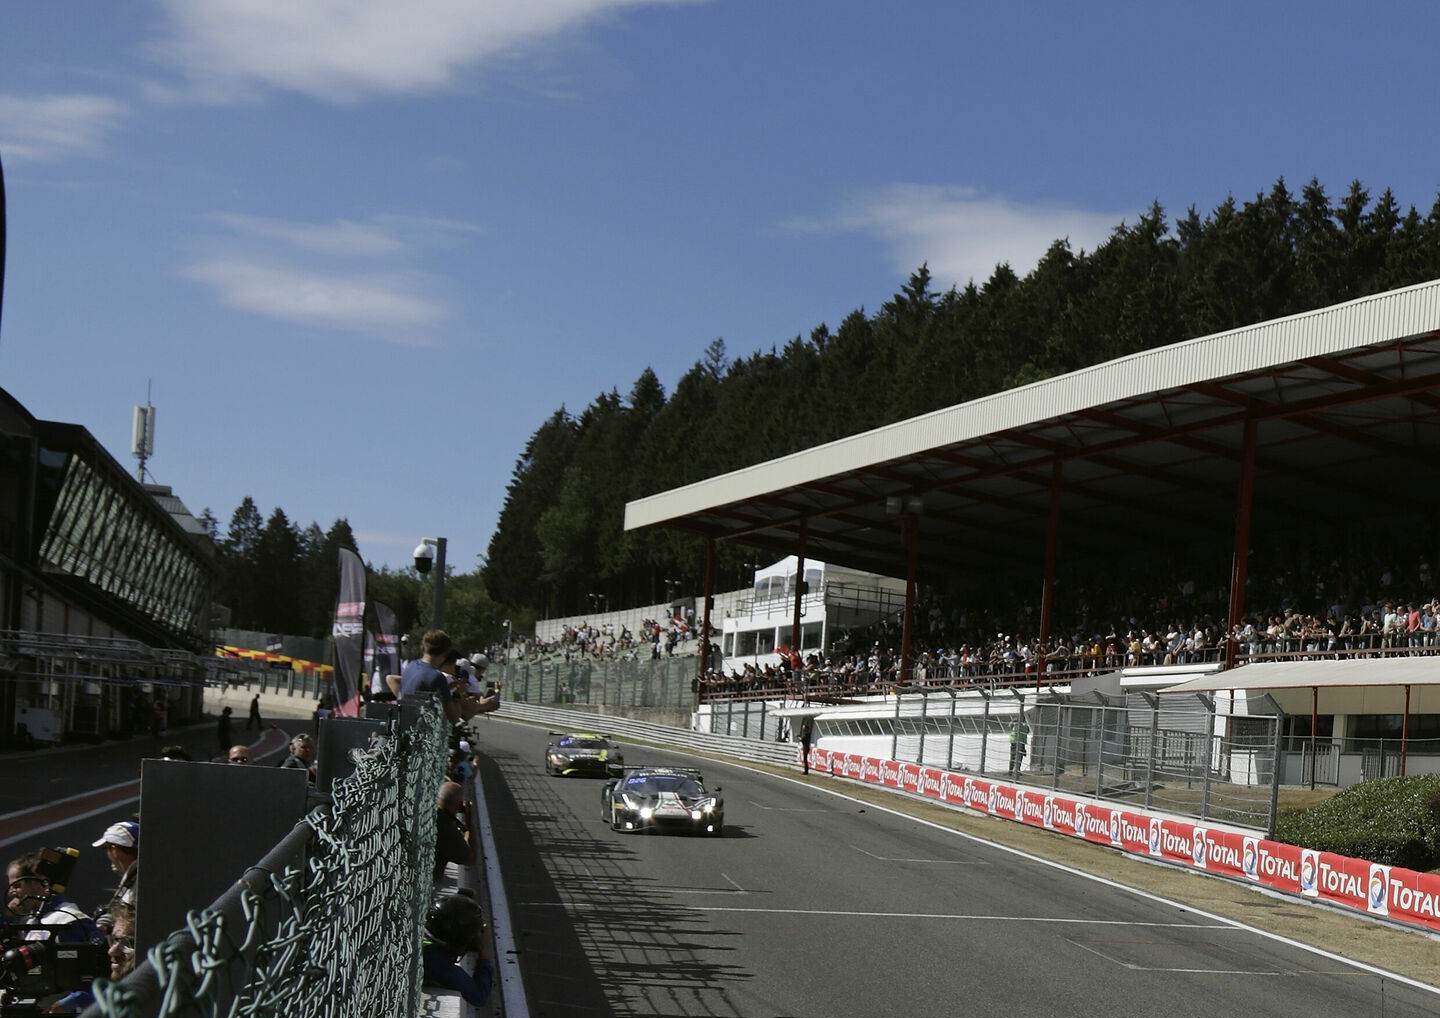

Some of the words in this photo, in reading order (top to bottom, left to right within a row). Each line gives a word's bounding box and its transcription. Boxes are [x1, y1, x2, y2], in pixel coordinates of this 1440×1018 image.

[904, 769, 918, 786] TOTAL
[924, 775, 940, 792] TOTAL
[947, 780, 963, 798] TOTAL
[971, 786, 988, 804] TOTAL
[996, 792, 1015, 812] TOTAL
[1023, 798, 1043, 819] TOTAL
[1052, 805, 1075, 827] TOTAL
[1085, 813, 1110, 836] TOTAL
[1121, 819, 1149, 845] TOTAL
[1161, 828, 1192, 856] TOTAL
[1207, 838, 1242, 868] TOTAL
[1260, 850, 1299, 881] TOTAL
[1320, 863, 1366, 899] TOTAL
